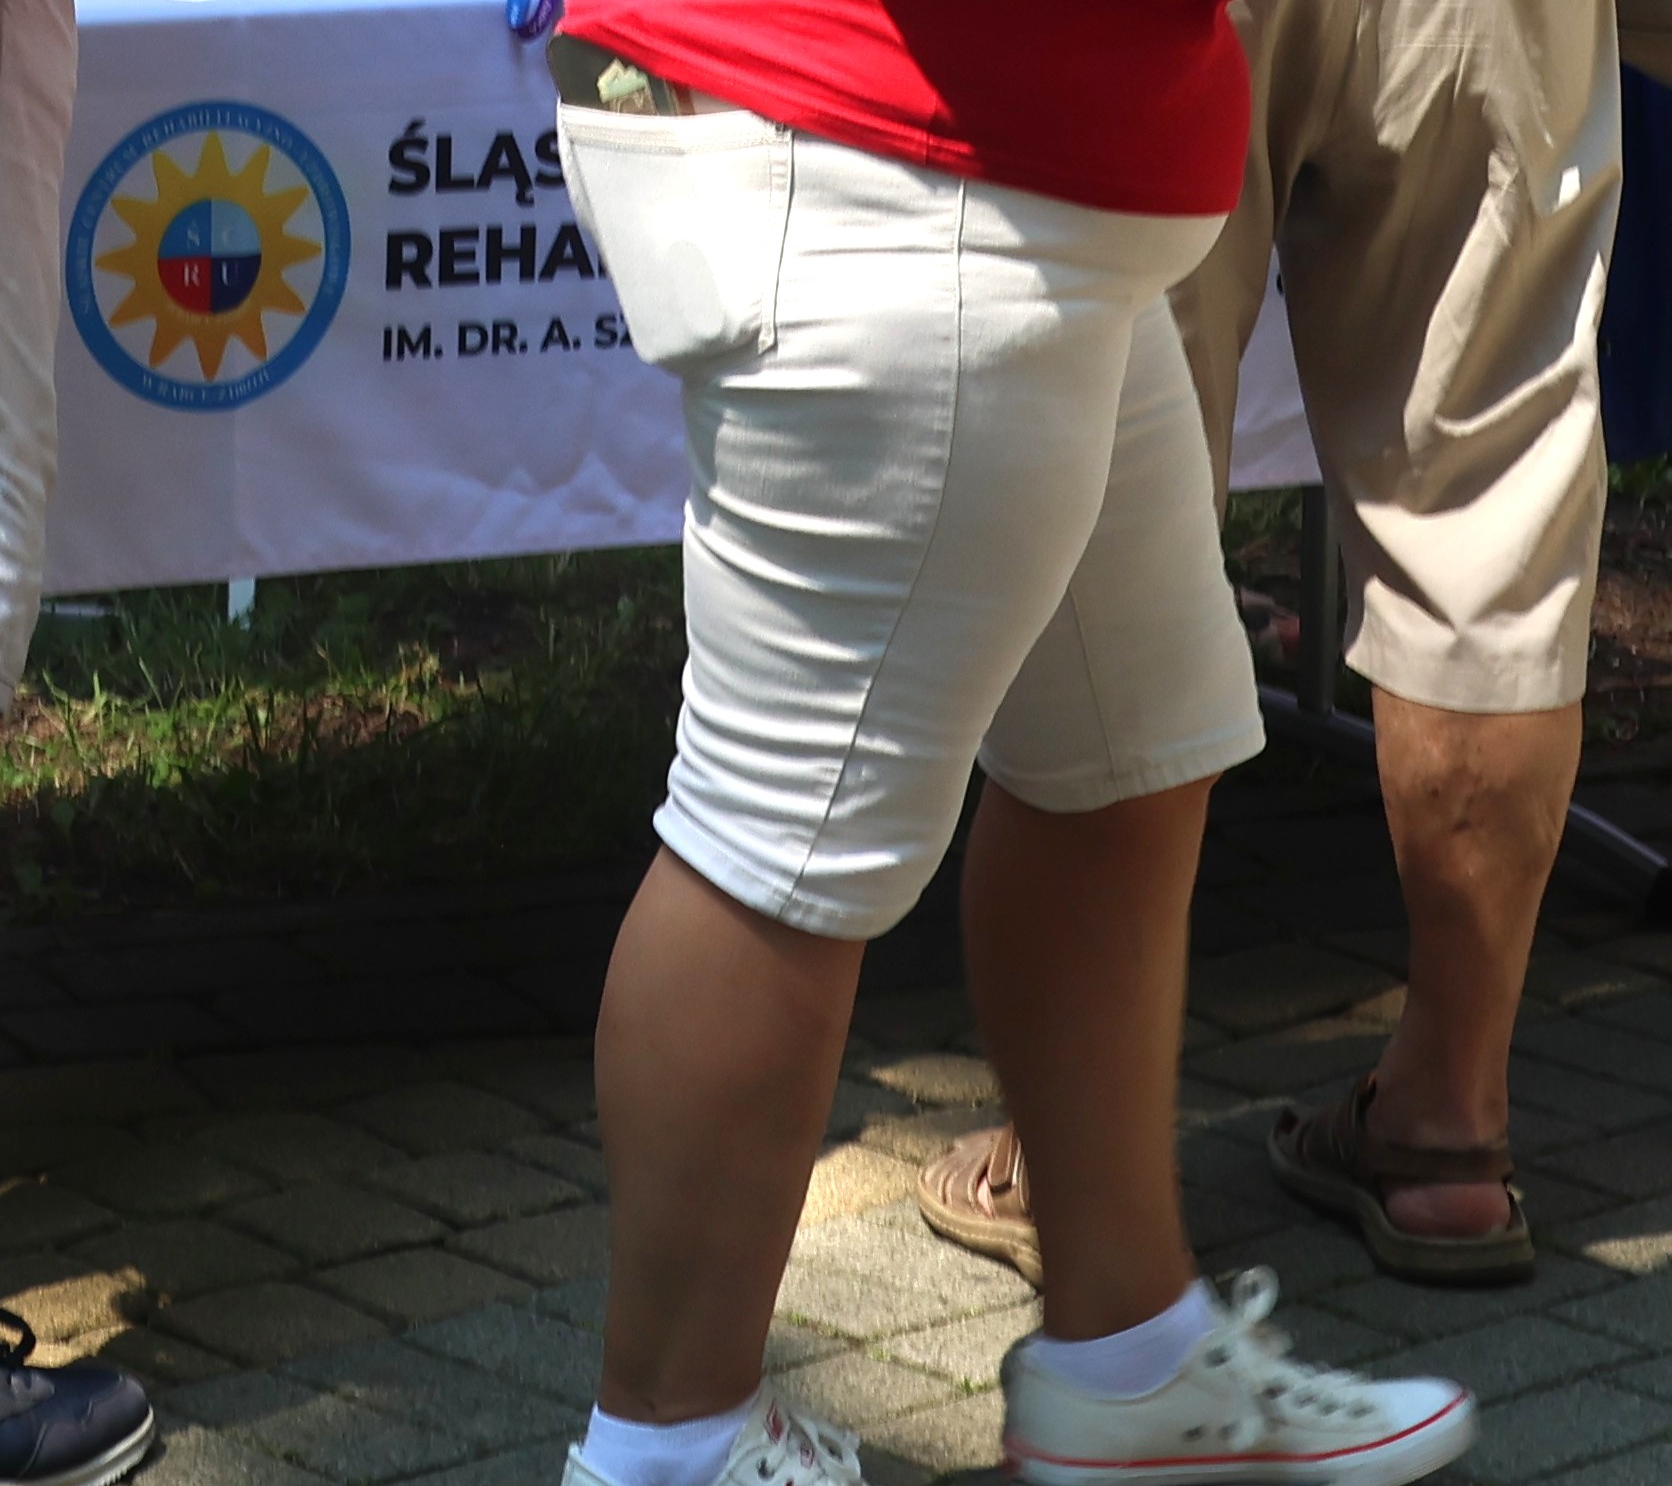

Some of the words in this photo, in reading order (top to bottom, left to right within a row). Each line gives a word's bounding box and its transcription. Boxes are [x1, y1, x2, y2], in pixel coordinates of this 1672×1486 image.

[387, 117, 566, 209] ŚLĄS
[385, 220, 612, 292] REHA
[382, 321, 444, 362] IM.
[457, 318, 529, 357] DR.
[539, 315, 582, 353] A.
